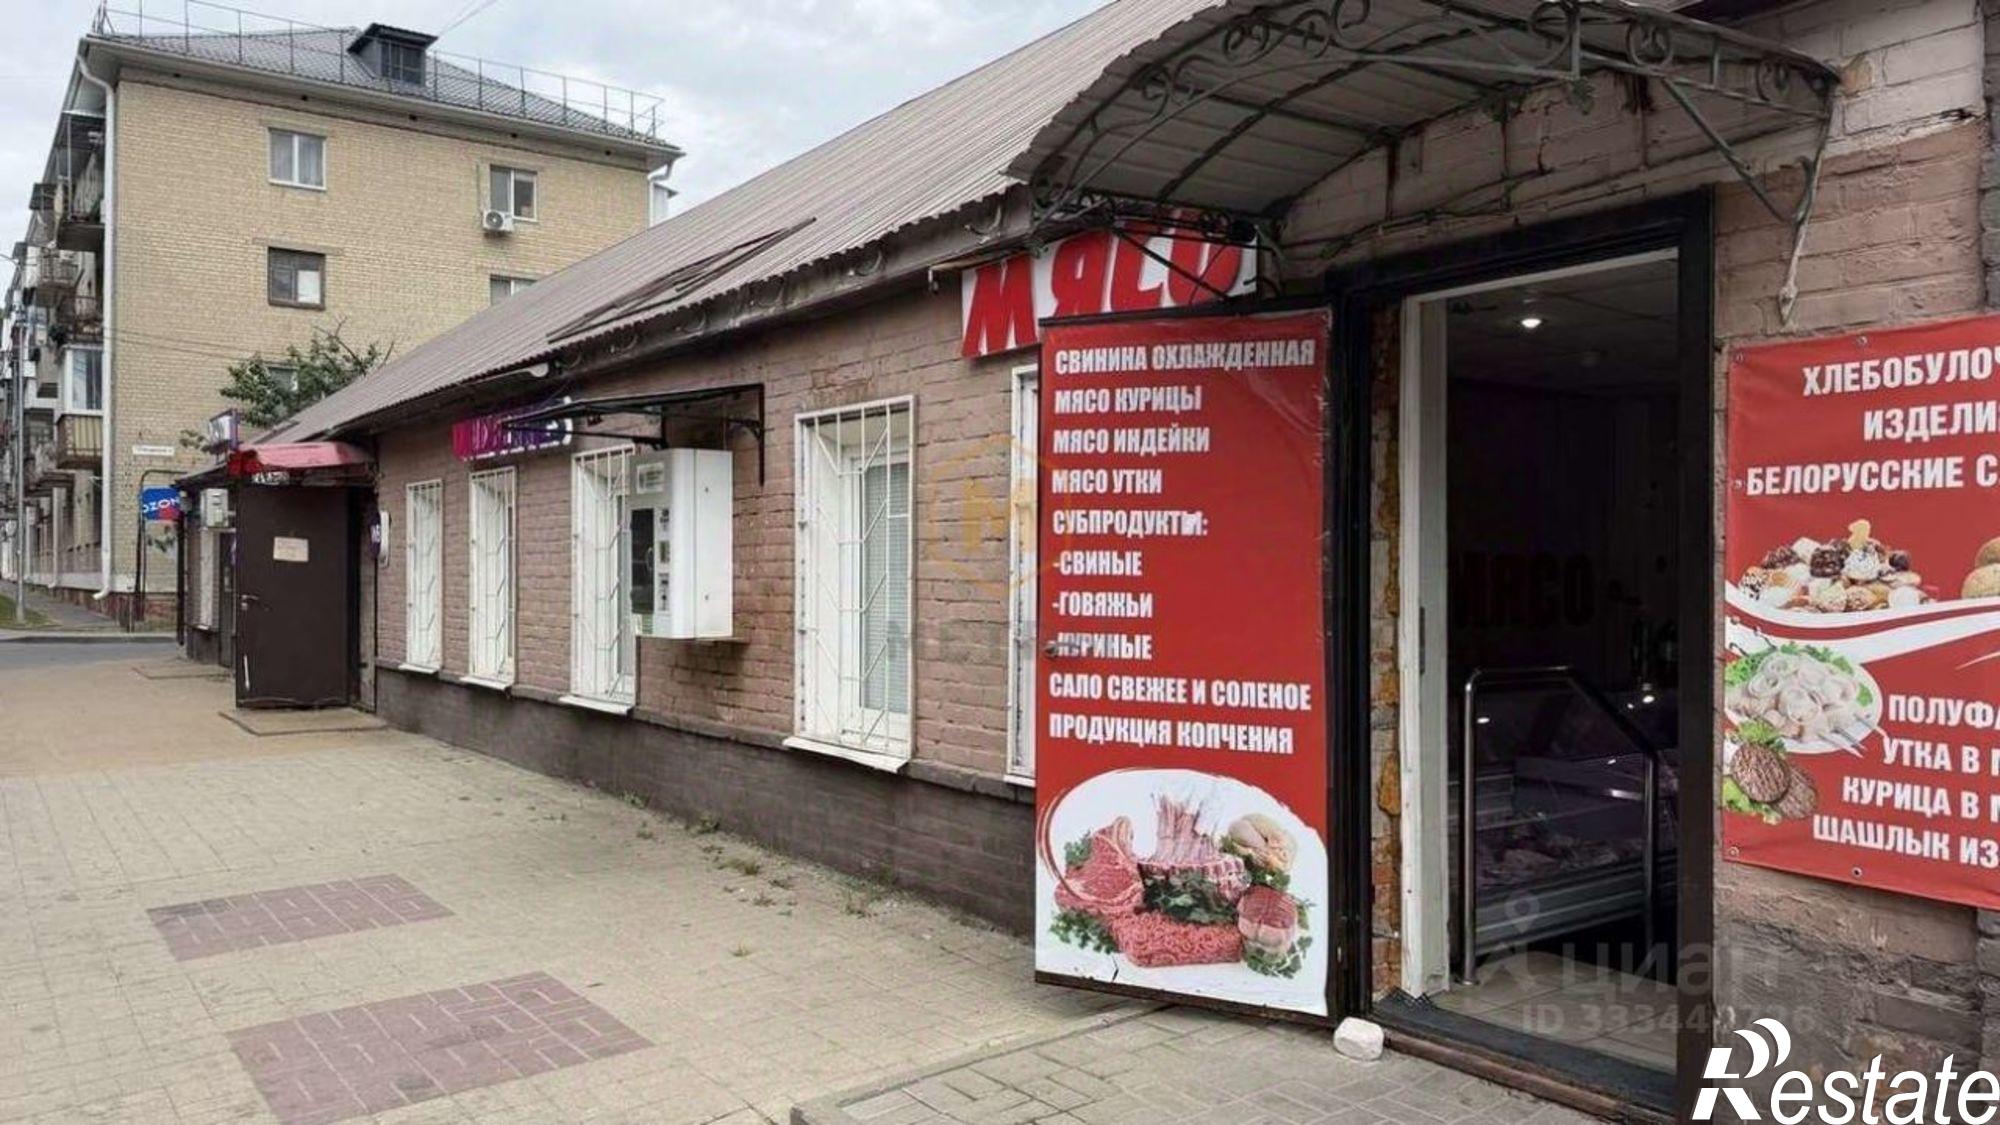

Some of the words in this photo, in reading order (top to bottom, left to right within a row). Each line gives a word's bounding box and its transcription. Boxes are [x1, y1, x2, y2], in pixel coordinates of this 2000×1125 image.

[962, 212, 1244, 357] МЯСО
[1055, 346, 1148, 375] СВИНИНА
[1151, 339, 1316, 371] ОХЛАЖДЕННАЯ
[1054, 388, 1110, 414] МЯСО
[1115, 385, 1202, 413] КУРИЦЫ
[1053, 429, 1109, 454] МЯСО
[1113, 423, 1210, 456] ИНДЕЙКИ
[1864, 400, 2000, 443] ИЗДЕЛИ
[1052, 469, 1108, 494] МЯСО
[1112, 469, 1162, 494] УТКИ
[1747, 456, 1964, 496] БЕЛОРУССКИЕ
[1976, 454, 2000, 487] С
[1053, 510, 1208, 537] СУБПРОДУКТЫ:
[1053, 550, 1143, 576] -СВИНЫЕ
[1052, 591, 1153, 618] -ГОВЯЖЬИ
[1049, 673, 1102, 699] САЛО
[1107, 676, 1187, 704] СВЕЖЕЕ
[1192, 679, 1206, 705] И
[1211, 681, 1312, 711] СОЛЕНОЕ
[1889, 694, 2000, 730] ПОЛУФ
[1050, 713, 1172, 747] ПРОДУКЦИЯ
[1177, 721, 1293, 754] КОПЧЕНИЯ
[1883, 737, 1952, 771] УТКА
[1962, 746, 1980, 774] В
[1843, 776, 1952, 818] КУРИЦА
[1961, 791, 1980, 820] В
[1813, 814, 1950, 861] ШАШЛЫК
[1960, 836, 1999, 868] ИЗ
